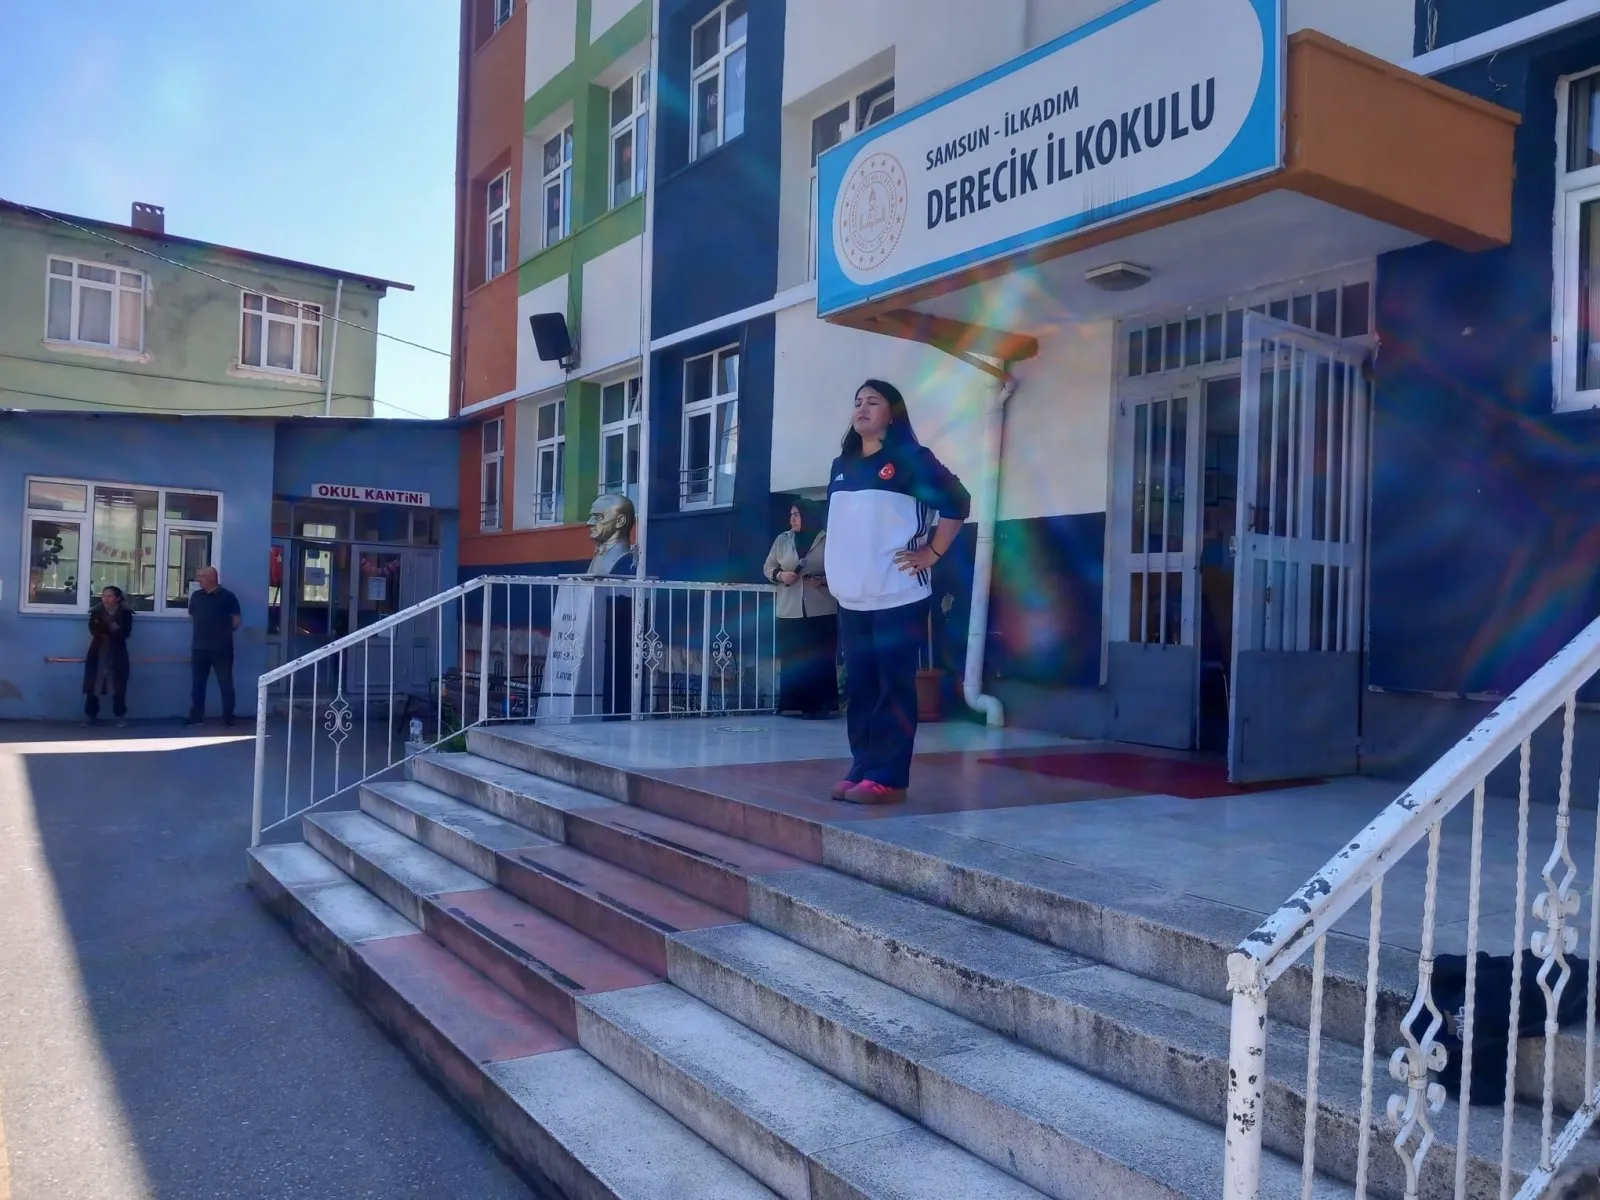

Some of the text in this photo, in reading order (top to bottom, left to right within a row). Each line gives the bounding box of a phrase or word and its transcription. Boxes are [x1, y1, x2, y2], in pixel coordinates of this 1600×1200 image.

[926, 125, 990, 171] SAMSUN
[1004, 86, 1079, 137] İLKADIM
[927, 148, 1038, 229] DERECİK
[1046, 77, 1215, 185] İLKOKULU
[318, 485, 360, 499] OKUL
